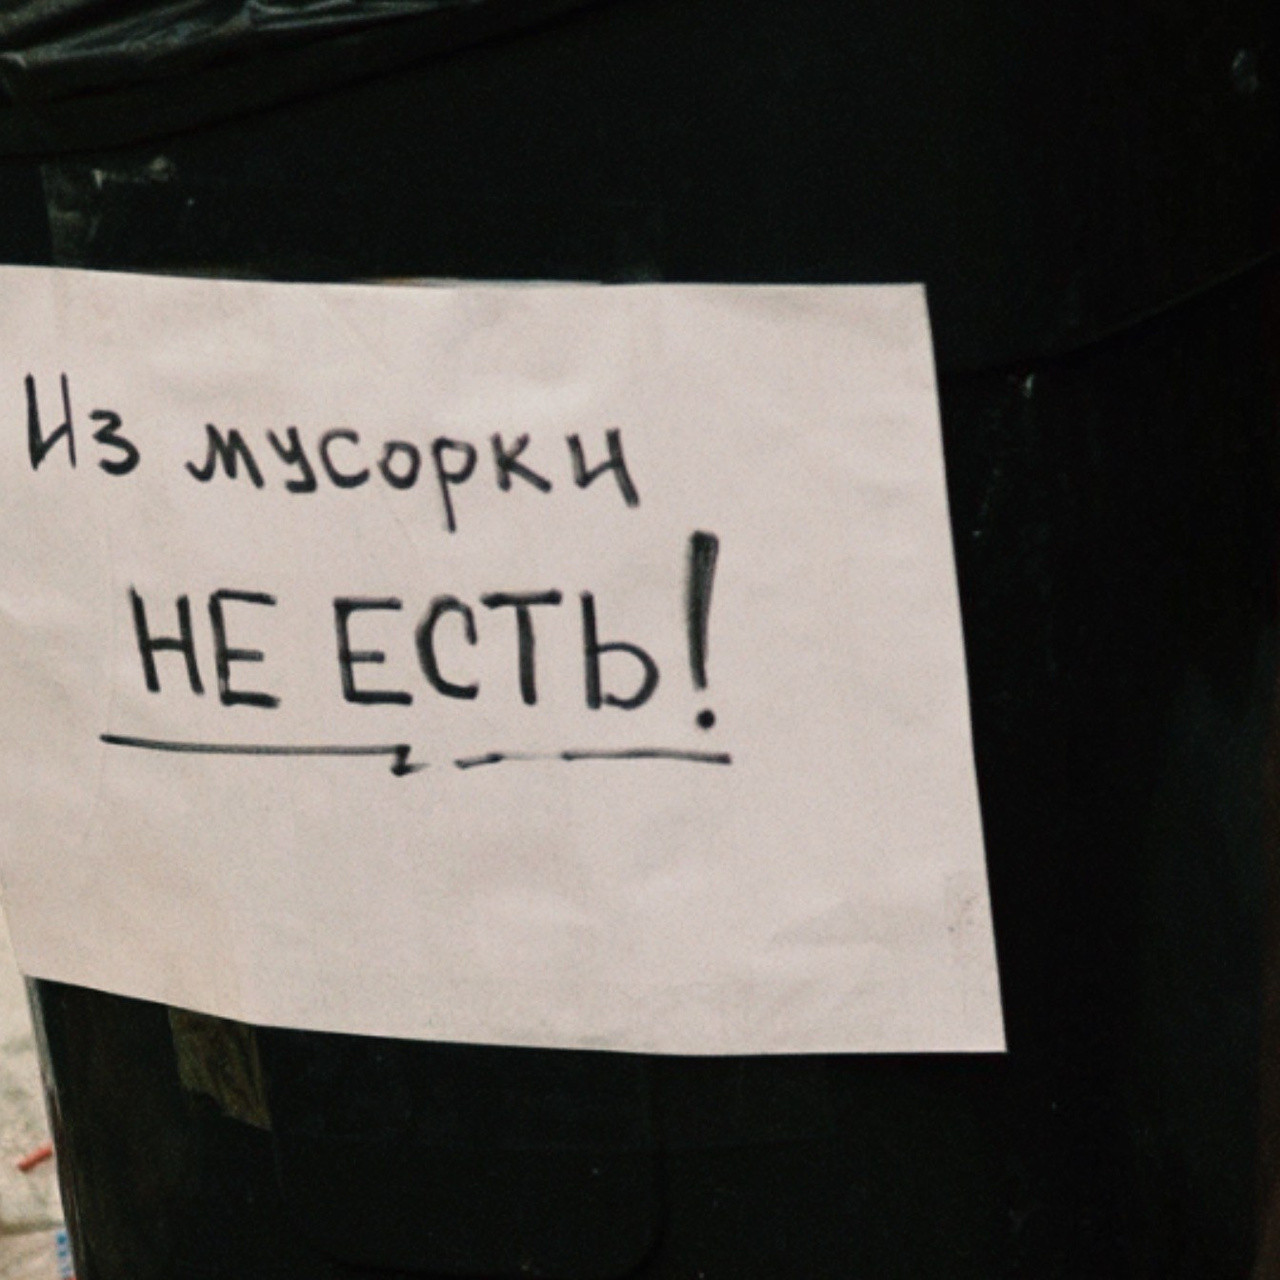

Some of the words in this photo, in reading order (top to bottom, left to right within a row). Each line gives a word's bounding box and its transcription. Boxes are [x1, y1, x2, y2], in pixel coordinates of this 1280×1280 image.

[24, 373, 140, 476] Из
[185, 423, 640, 532] мусорки
[129, 587, 281, 710] НЕ
[332, 530, 720, 730] ЕСТЬ!
